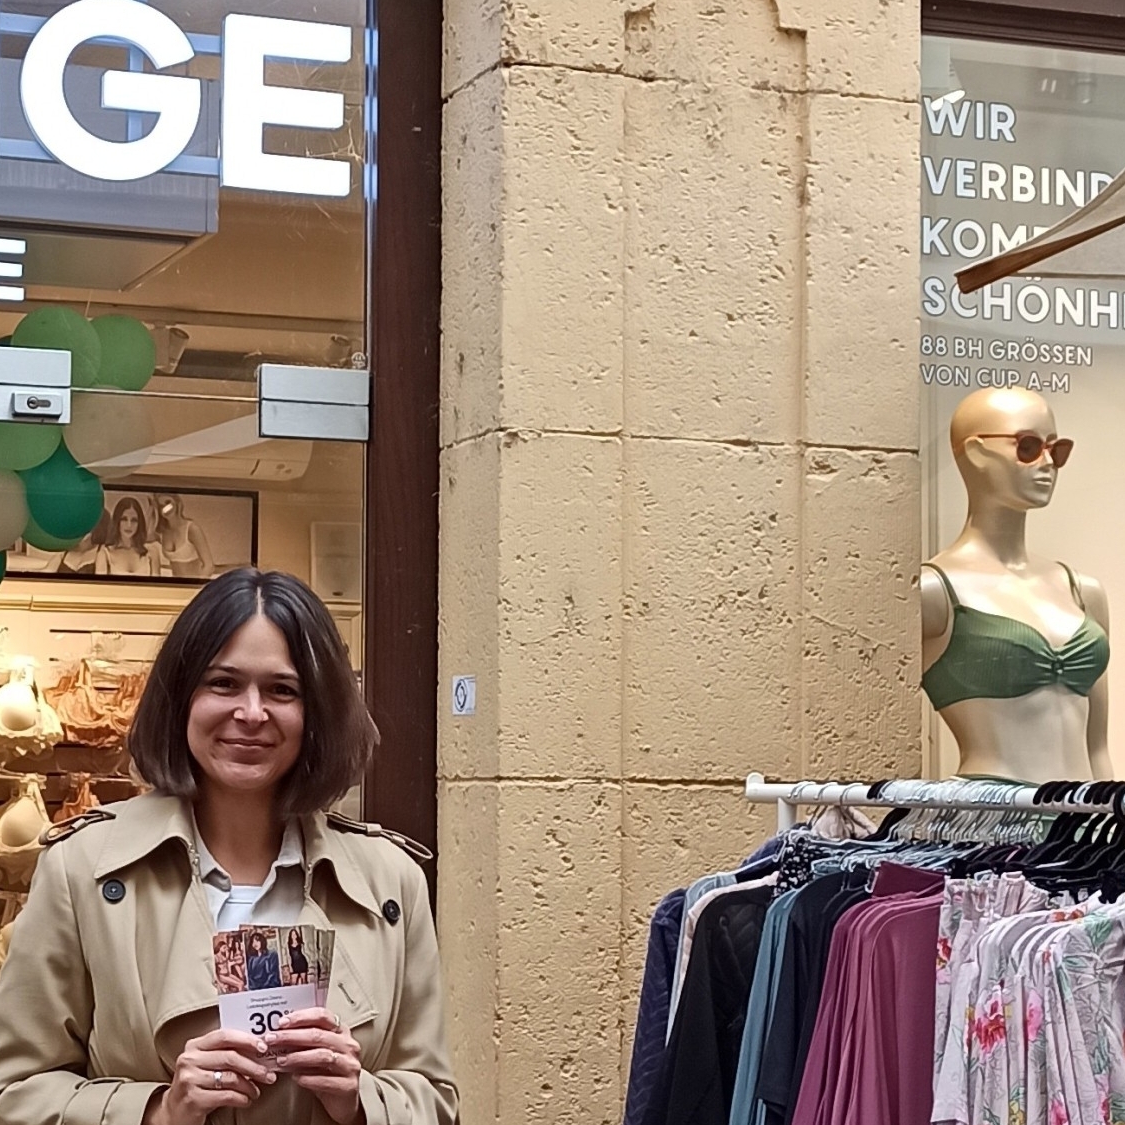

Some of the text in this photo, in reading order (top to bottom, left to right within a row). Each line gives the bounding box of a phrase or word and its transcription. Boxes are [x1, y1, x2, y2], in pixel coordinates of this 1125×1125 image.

[923, 96, 1016, 142] WIR
[922, 216, 1052, 258] KOM
[923, 276, 1125, 330] SCHÖNH
[922, 336, 1093, 366] 88 BH GRÖSSEN
[920, 364, 1070, 393] VON CUP A-M
